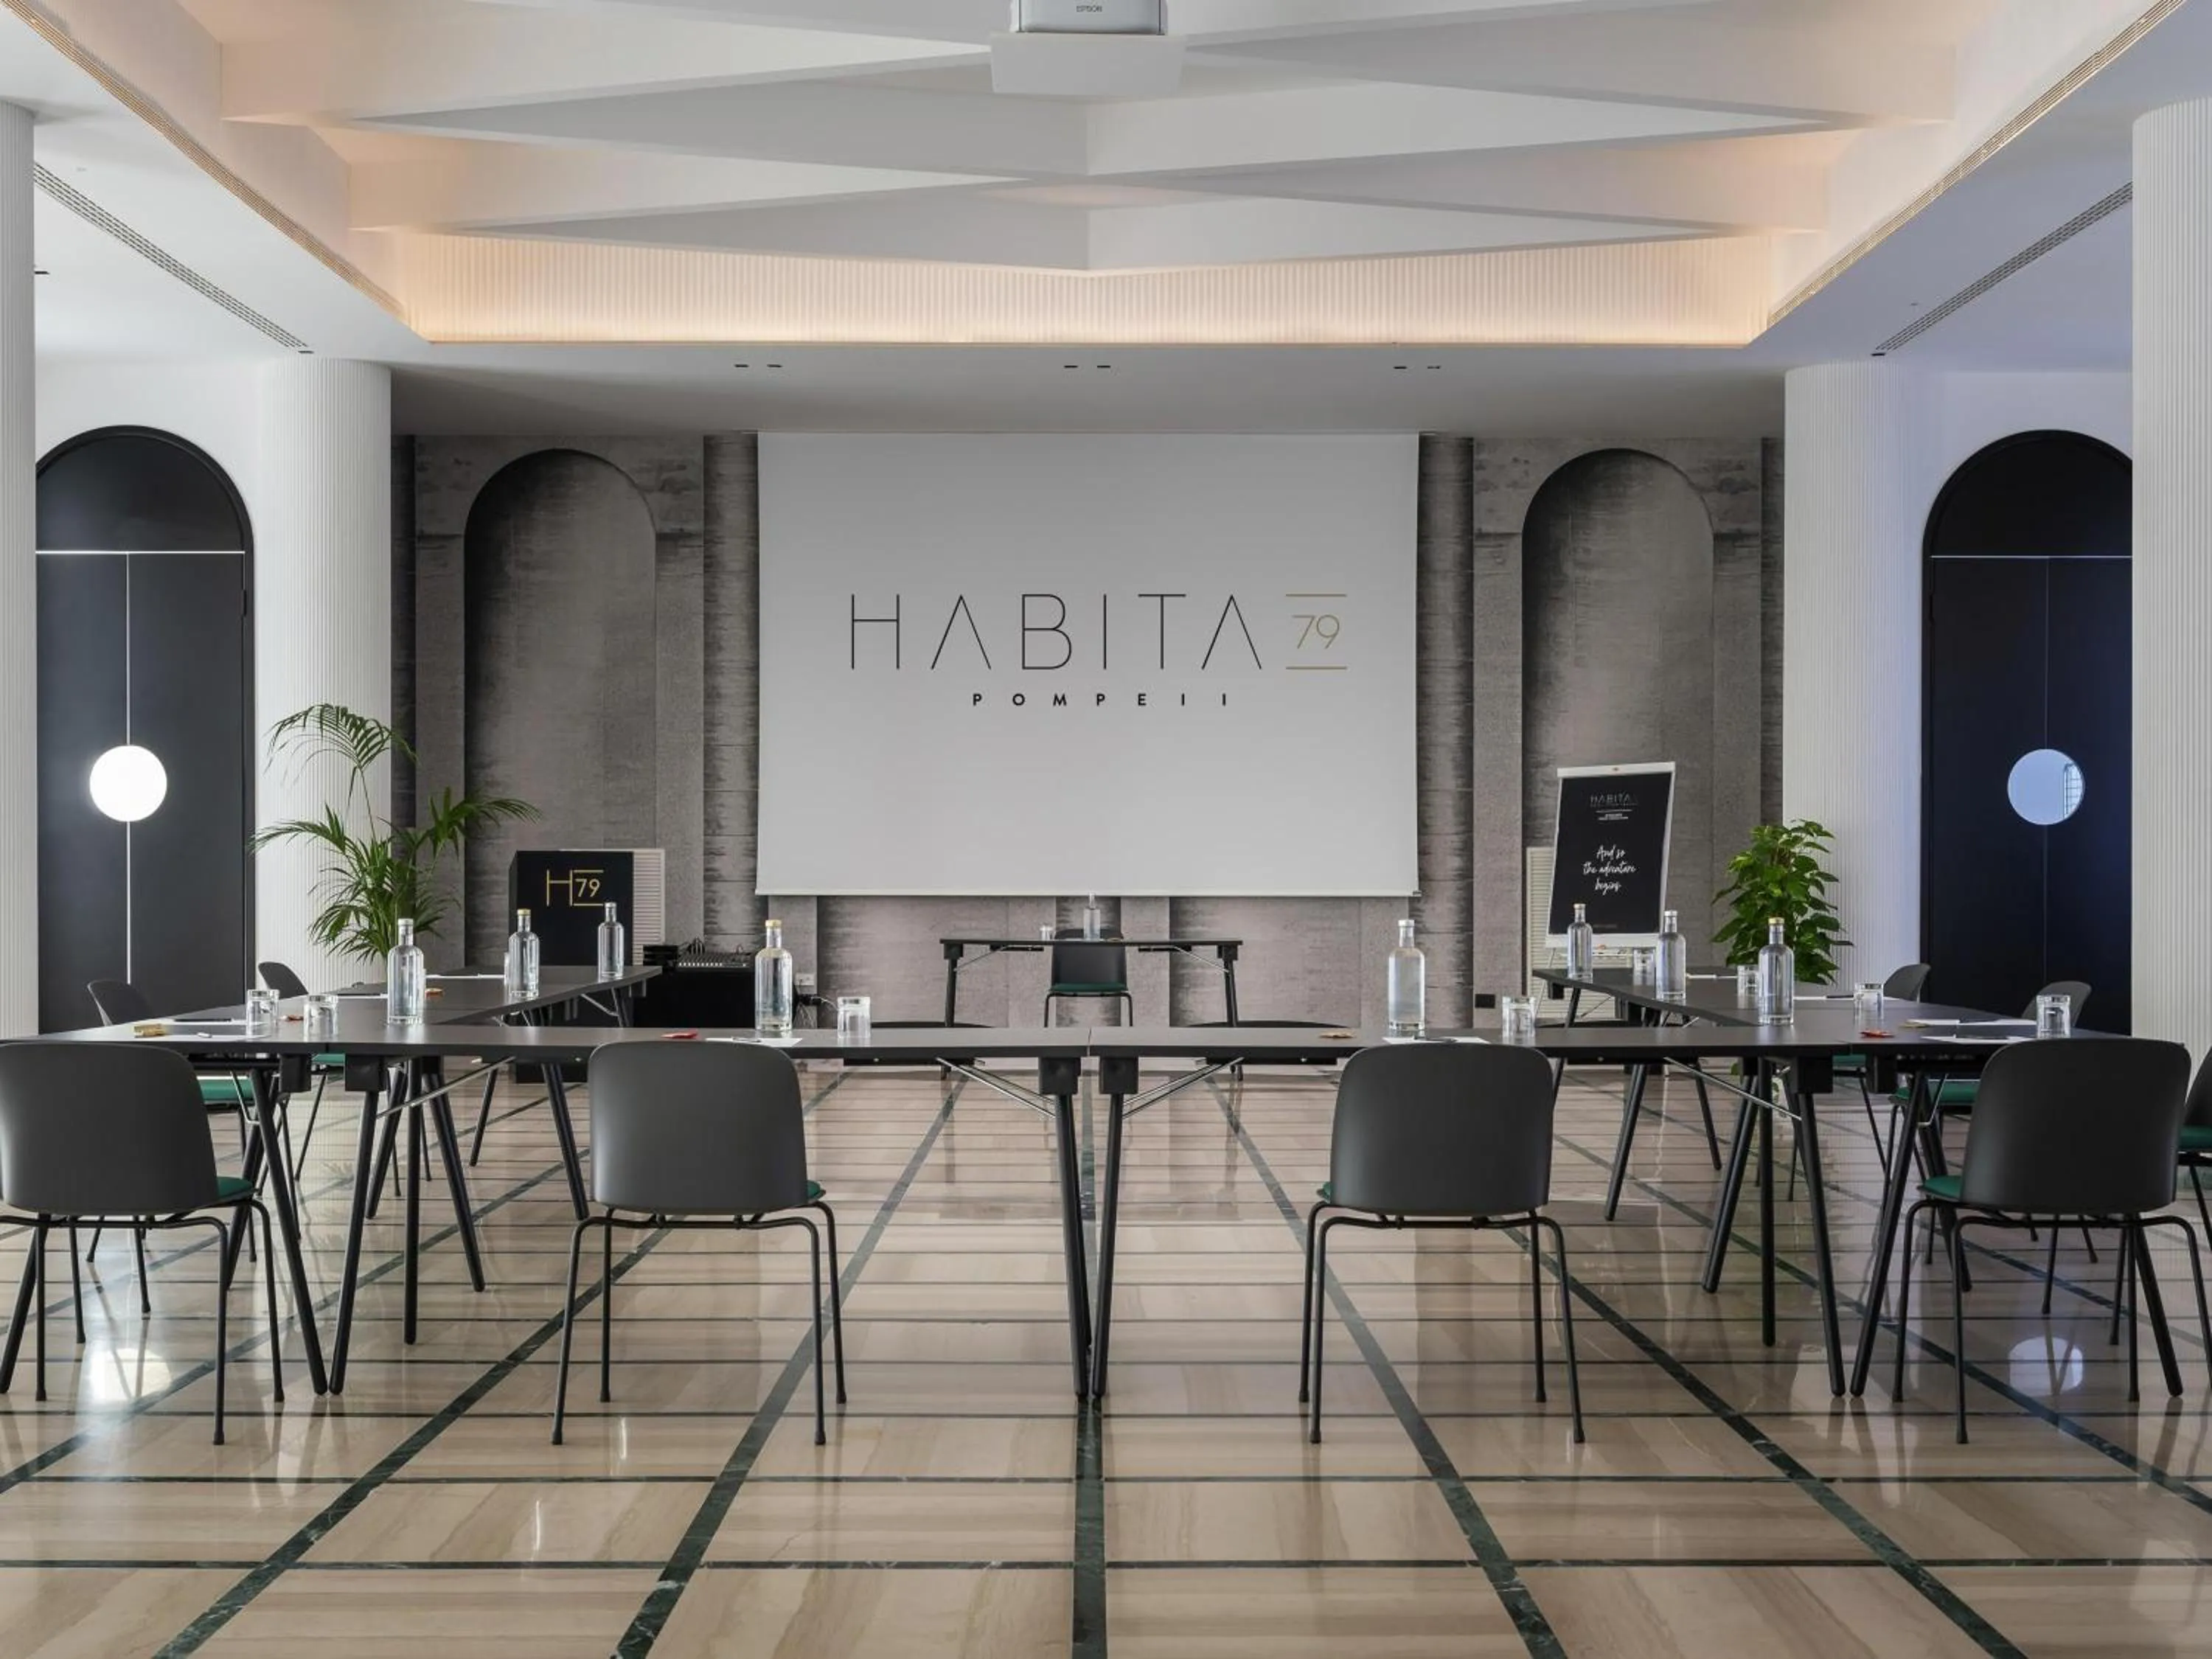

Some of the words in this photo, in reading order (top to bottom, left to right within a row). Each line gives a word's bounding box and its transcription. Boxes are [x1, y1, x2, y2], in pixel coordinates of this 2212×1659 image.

[850, 594, 1262, 670] HABITA
[1292, 614, 1340, 650] 79
[973, 693, 1227, 706] POMPEII
[1596, 844, 1616, 861] And
[1615, 849, 1626, 860] so
[1599, 860, 1636, 877] adventure
